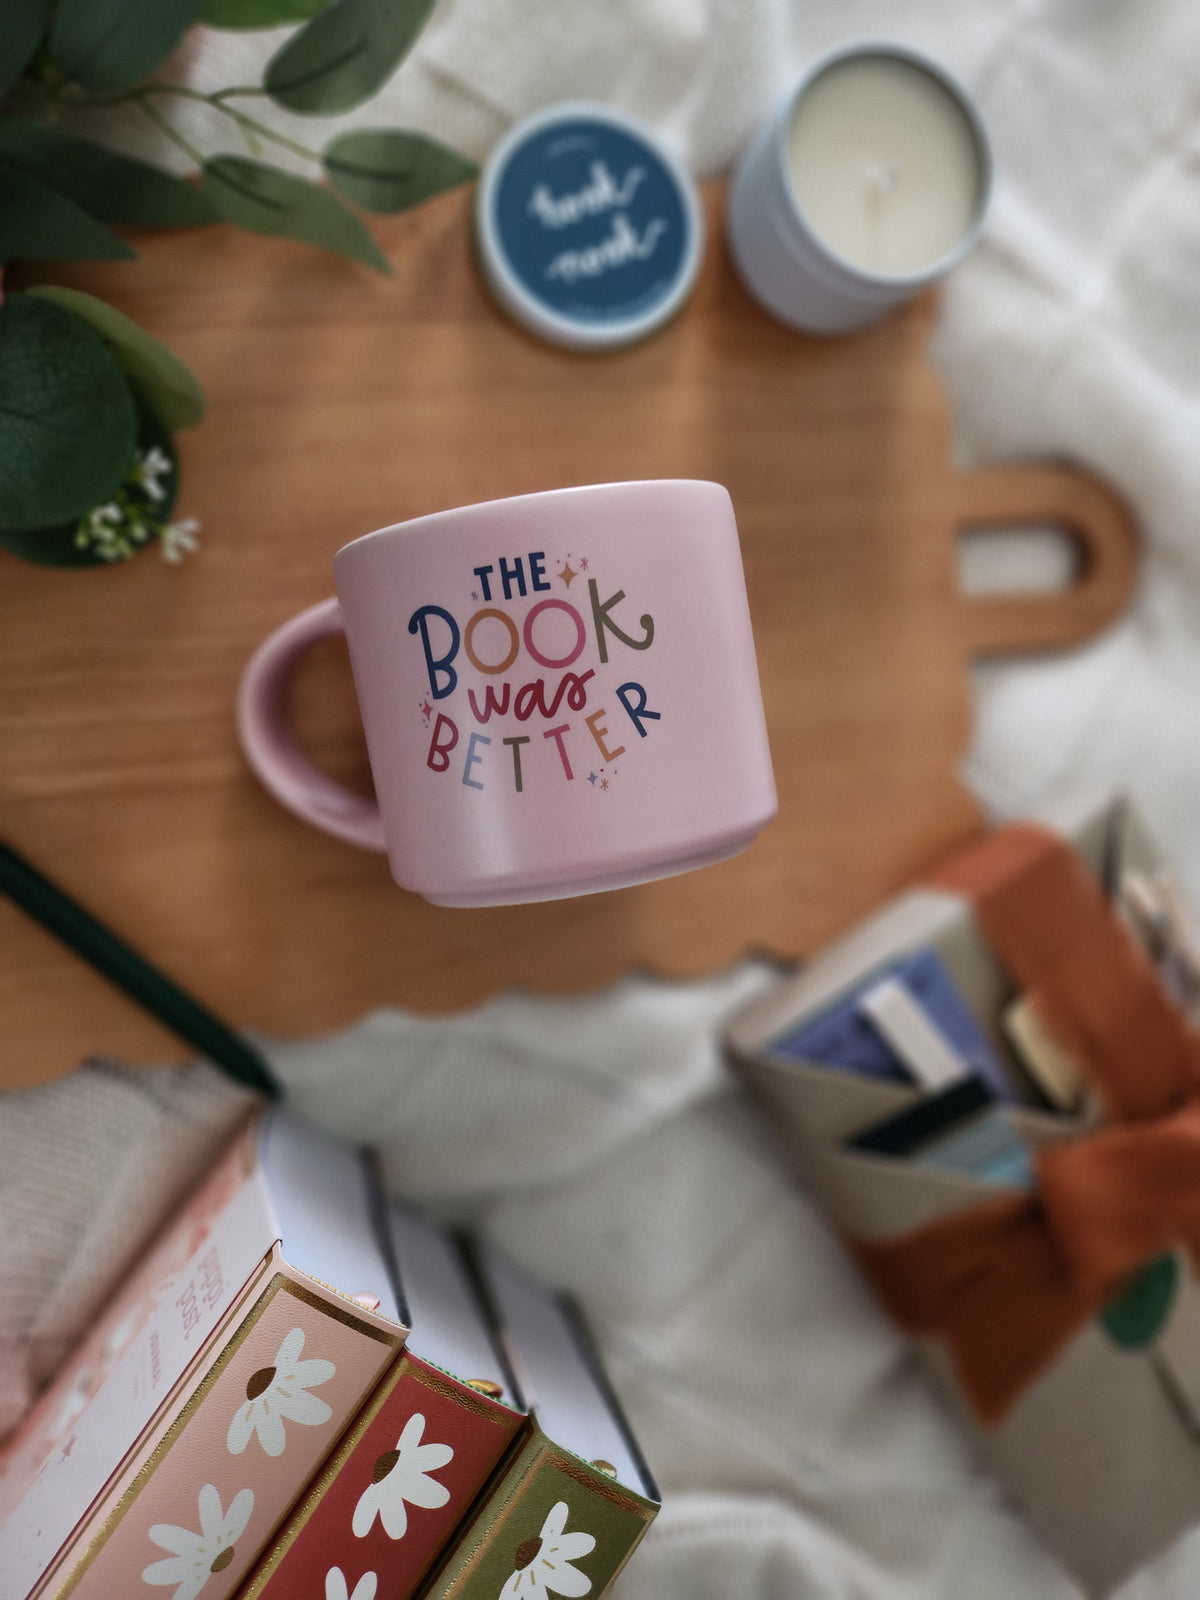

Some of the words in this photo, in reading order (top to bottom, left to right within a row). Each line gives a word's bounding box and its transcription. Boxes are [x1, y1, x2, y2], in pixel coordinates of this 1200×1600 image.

[473, 551, 551, 602] THE
[408, 578, 655, 700] BOOK
[426, 681, 661, 793] BETTER
[467, 668, 596, 725] was
